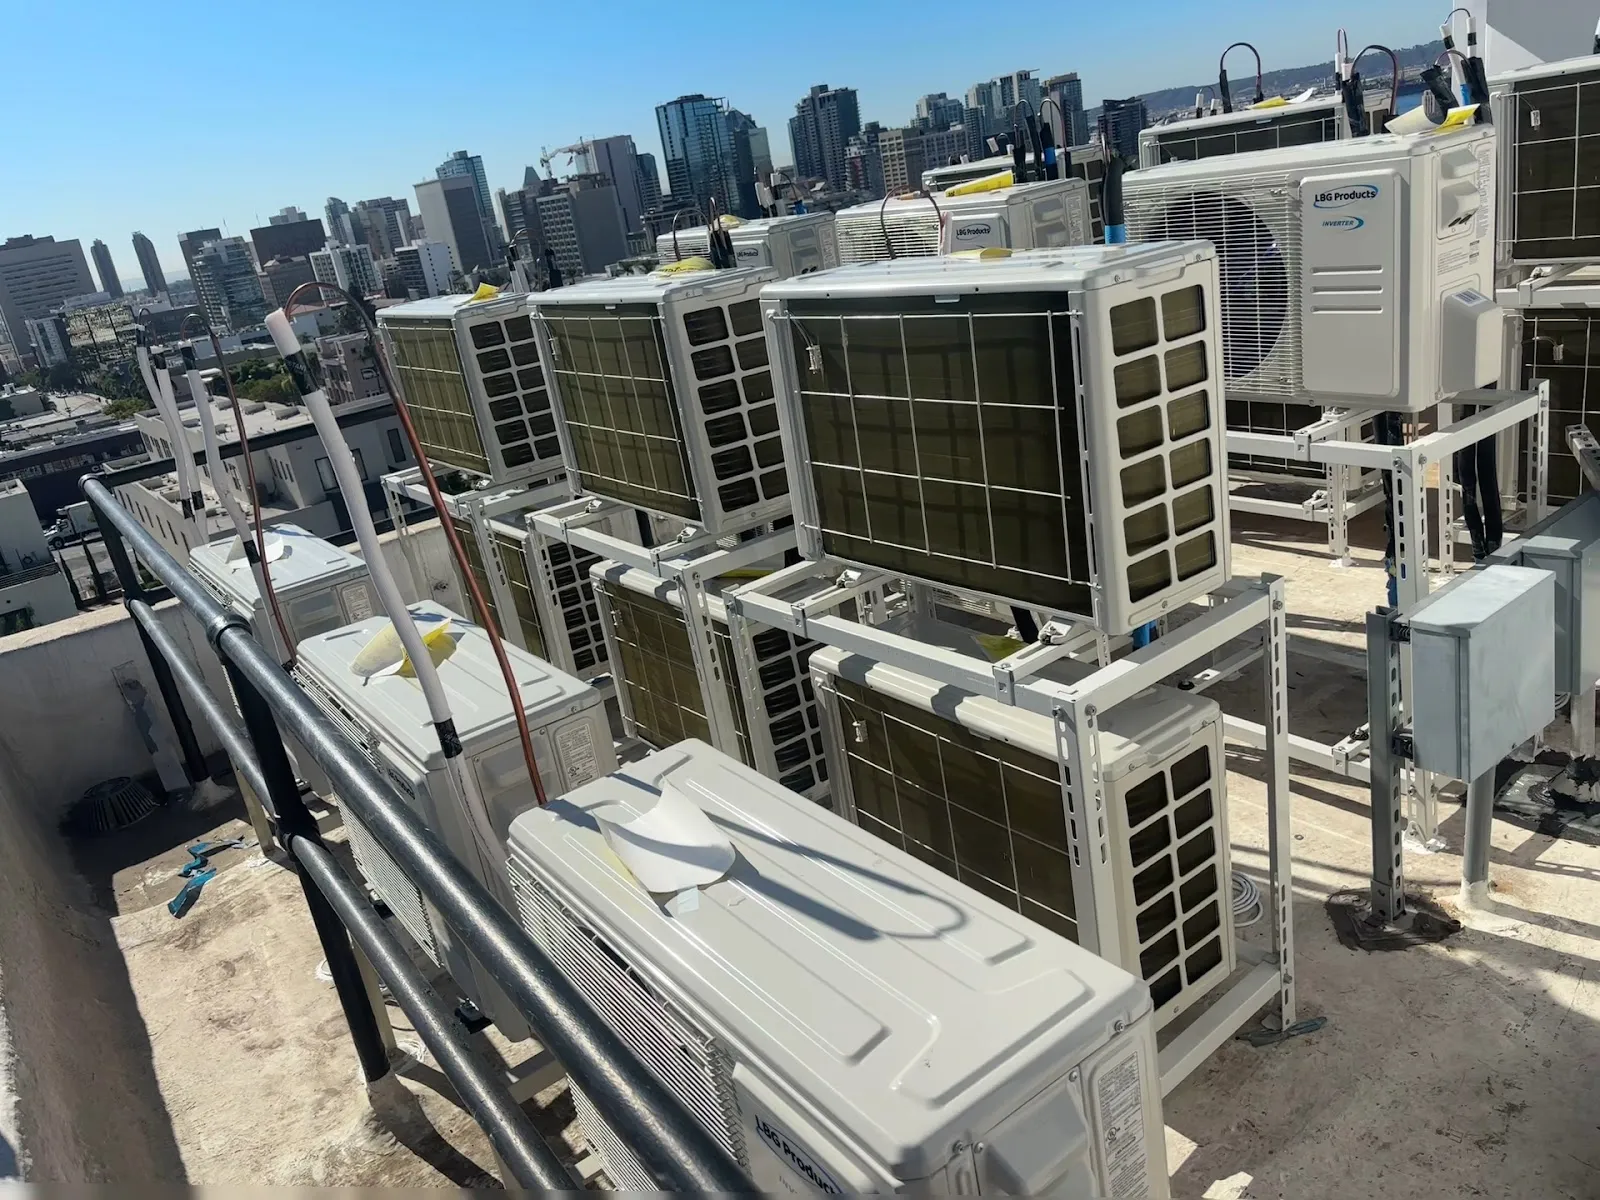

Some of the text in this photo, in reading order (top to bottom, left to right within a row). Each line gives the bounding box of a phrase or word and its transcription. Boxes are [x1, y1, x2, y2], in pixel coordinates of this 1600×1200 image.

[1315, 190, 1376, 202] LBG Products
[755, 1114, 781, 1148] LBG
[782, 1141, 835, 1194] Product
